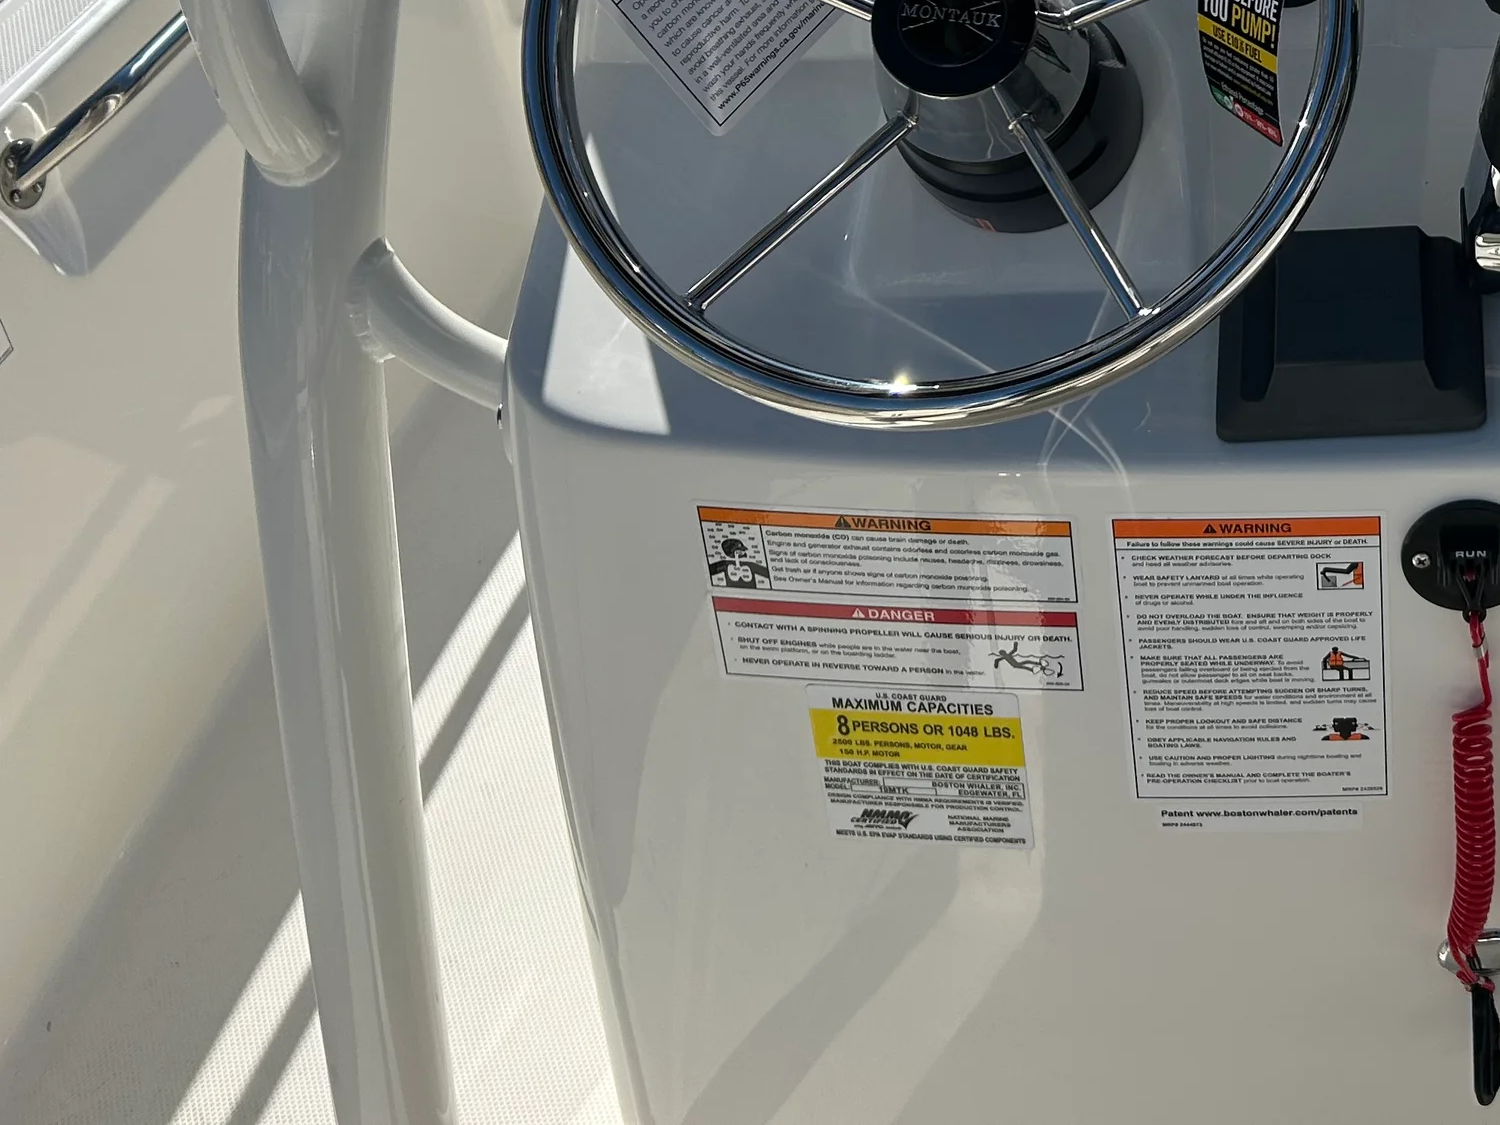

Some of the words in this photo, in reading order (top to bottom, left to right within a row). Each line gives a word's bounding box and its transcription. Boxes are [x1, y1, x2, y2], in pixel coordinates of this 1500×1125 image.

[901, 3, 1001, 28] MONTAUK
[1232, 3, 1276, 49] PUMP!
[1212, 24, 1226, 43] USE
[1227, 34, 1239, 51] E10
[1245, 42, 1262, 63] FUEL
[852, 517, 931, 532] WARNING
[1219, 523, 1292, 533] WARNING
[1455, 549, 1488, 559] RUN
[868, 609, 935, 621] DANGER
[735, 621, 773, 630] CONTACT
[776, 623, 797, 631] WITH
[808, 626, 847, 634] SPINNING
[850, 628, 900, 636] PROPELLER
[924, 631, 953, 639] CAUSE
[832, 697, 902, 711] MAXIMUM
[907, 702, 993, 715] CAPACITIES
[837, 715, 850, 736] 8
[852, 720, 919, 735] PERSONS
[923, 724, 944, 736] OR
[948, 726, 978, 737] 1048
[984, 727, 1015, 738] LBS.
[874, 740, 912, 749] PERSONS,
[872, 750, 900, 758] MOTOR
[1161, 809, 1194, 817] Patent
[1196, 808, 1358, 817] www.bostonwhaler.com/patents
